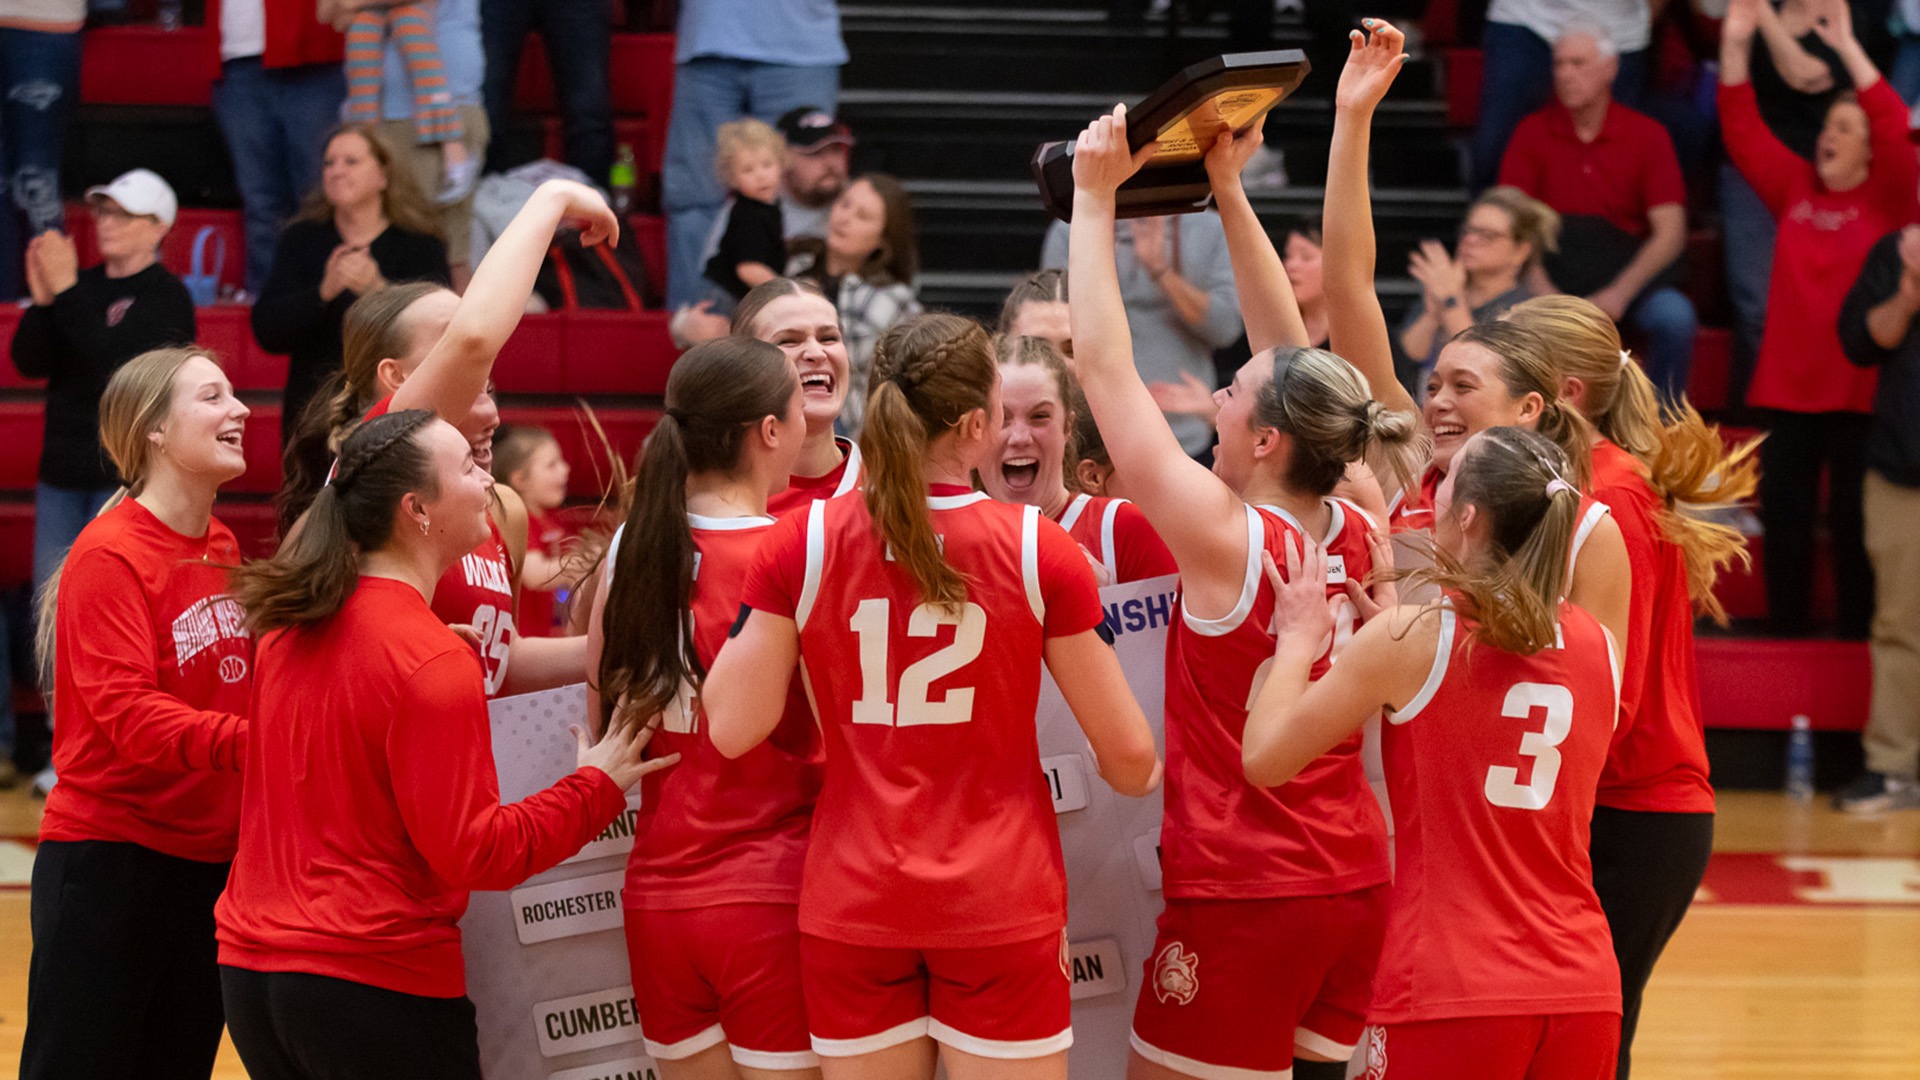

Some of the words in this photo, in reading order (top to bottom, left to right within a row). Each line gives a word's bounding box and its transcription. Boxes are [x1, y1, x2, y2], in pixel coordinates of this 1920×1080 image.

[462, 553, 513, 598] WILDC
[850, 598, 987, 727] 12
[1484, 681, 1574, 811] 3
[593, 809, 639, 842] AND
[522, 890, 616, 925] ROCHESTER
